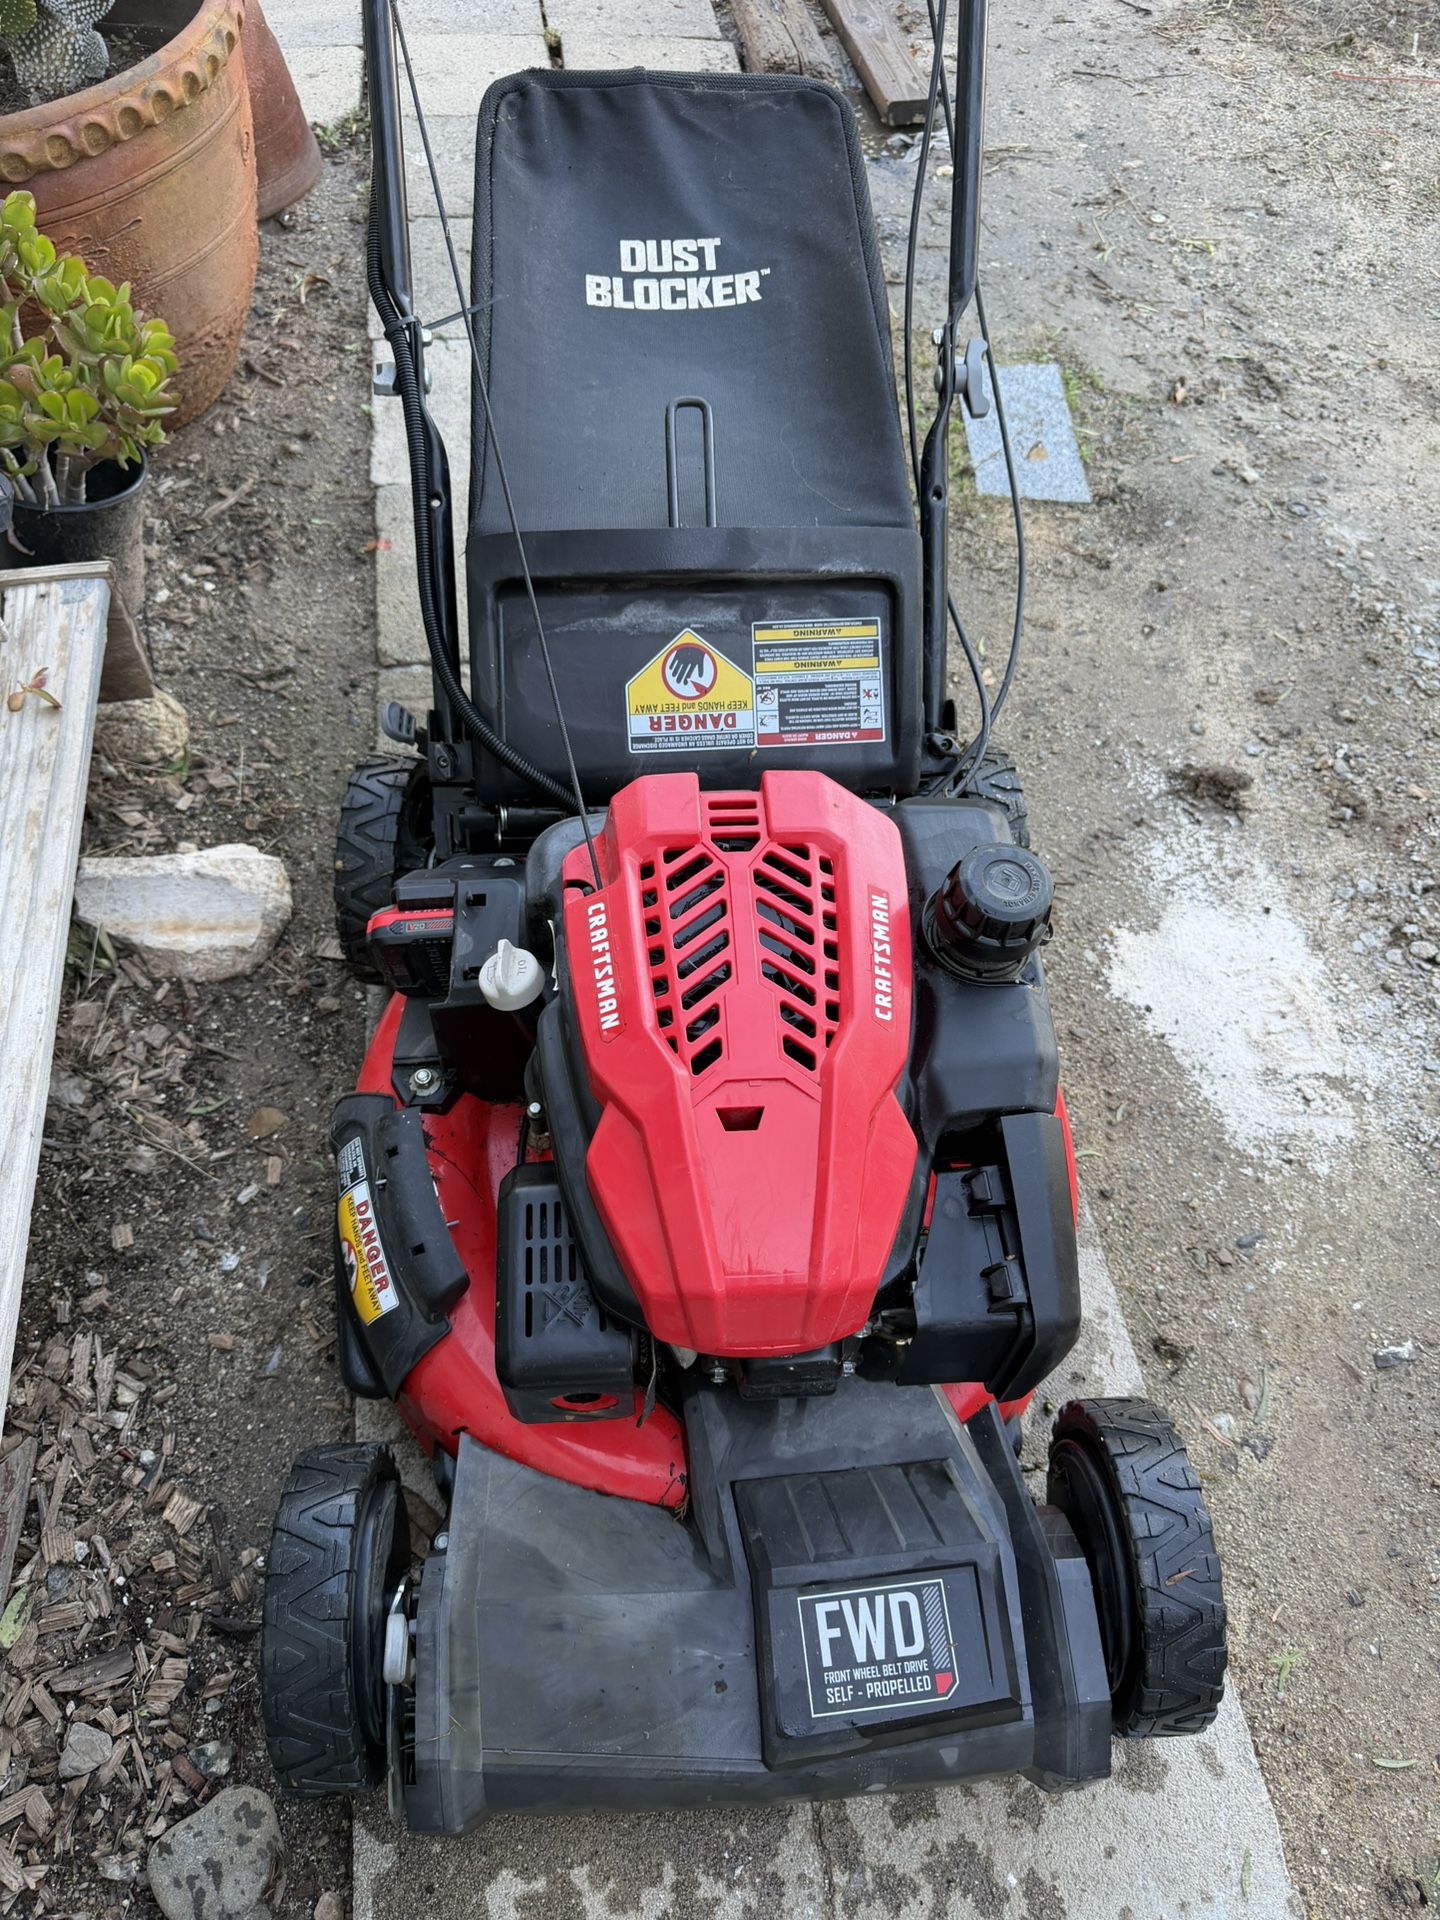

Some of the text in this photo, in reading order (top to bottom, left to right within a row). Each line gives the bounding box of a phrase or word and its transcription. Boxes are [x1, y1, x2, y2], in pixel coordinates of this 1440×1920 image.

[620, 238, 721, 273] DUST
[634, 700, 747, 713] KEEP HANDS and FEET AWAY
[649, 712, 737, 732] DANGER
[815, 732, 851, 740] DANGER
[516, 959, 527, 976] OIL
[588, 902, 619, 1030] CRAFTSMAN
[872, 894, 892, 1021] CRAFTSMAN
[347, 1196, 381, 1312] KEEP HANDS and FEET AWAY
[356, 1199, 390, 1294] DANGER
[815, 1592, 924, 1668] FWD
[824, 1659, 928, 1684] FRONT WHEEL BELT DRIVE
[827, 1686, 854, 1703] SELF
[866, 1675, 931, 1699] PROPELLED
